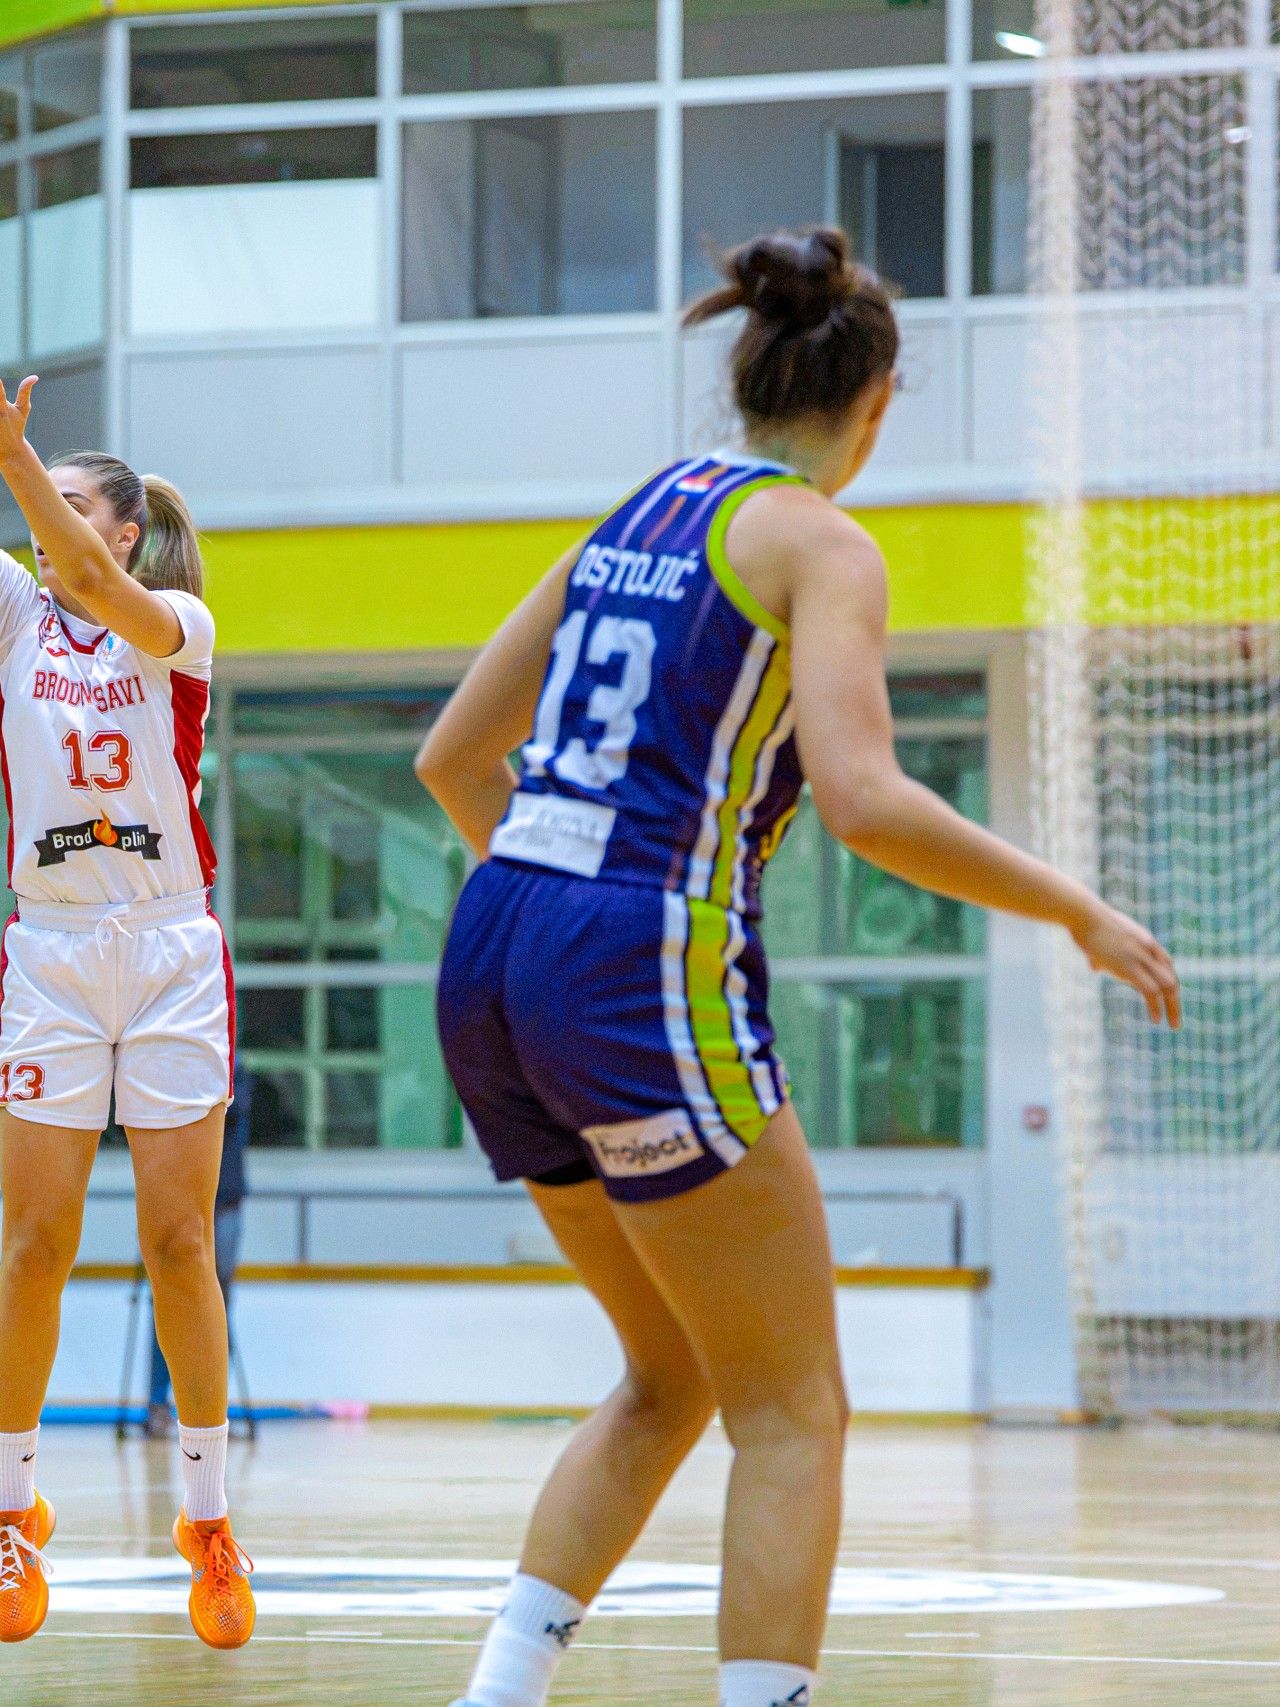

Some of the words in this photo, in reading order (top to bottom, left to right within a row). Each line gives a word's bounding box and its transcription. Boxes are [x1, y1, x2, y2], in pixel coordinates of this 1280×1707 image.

[571, 543, 699, 602] OSTOJIĆ
[522, 609, 657, 791] 13
[61, 728, 133, 794] 13
[52, 828, 93, 849] Brod
[121, 832, 147, 851] plin
